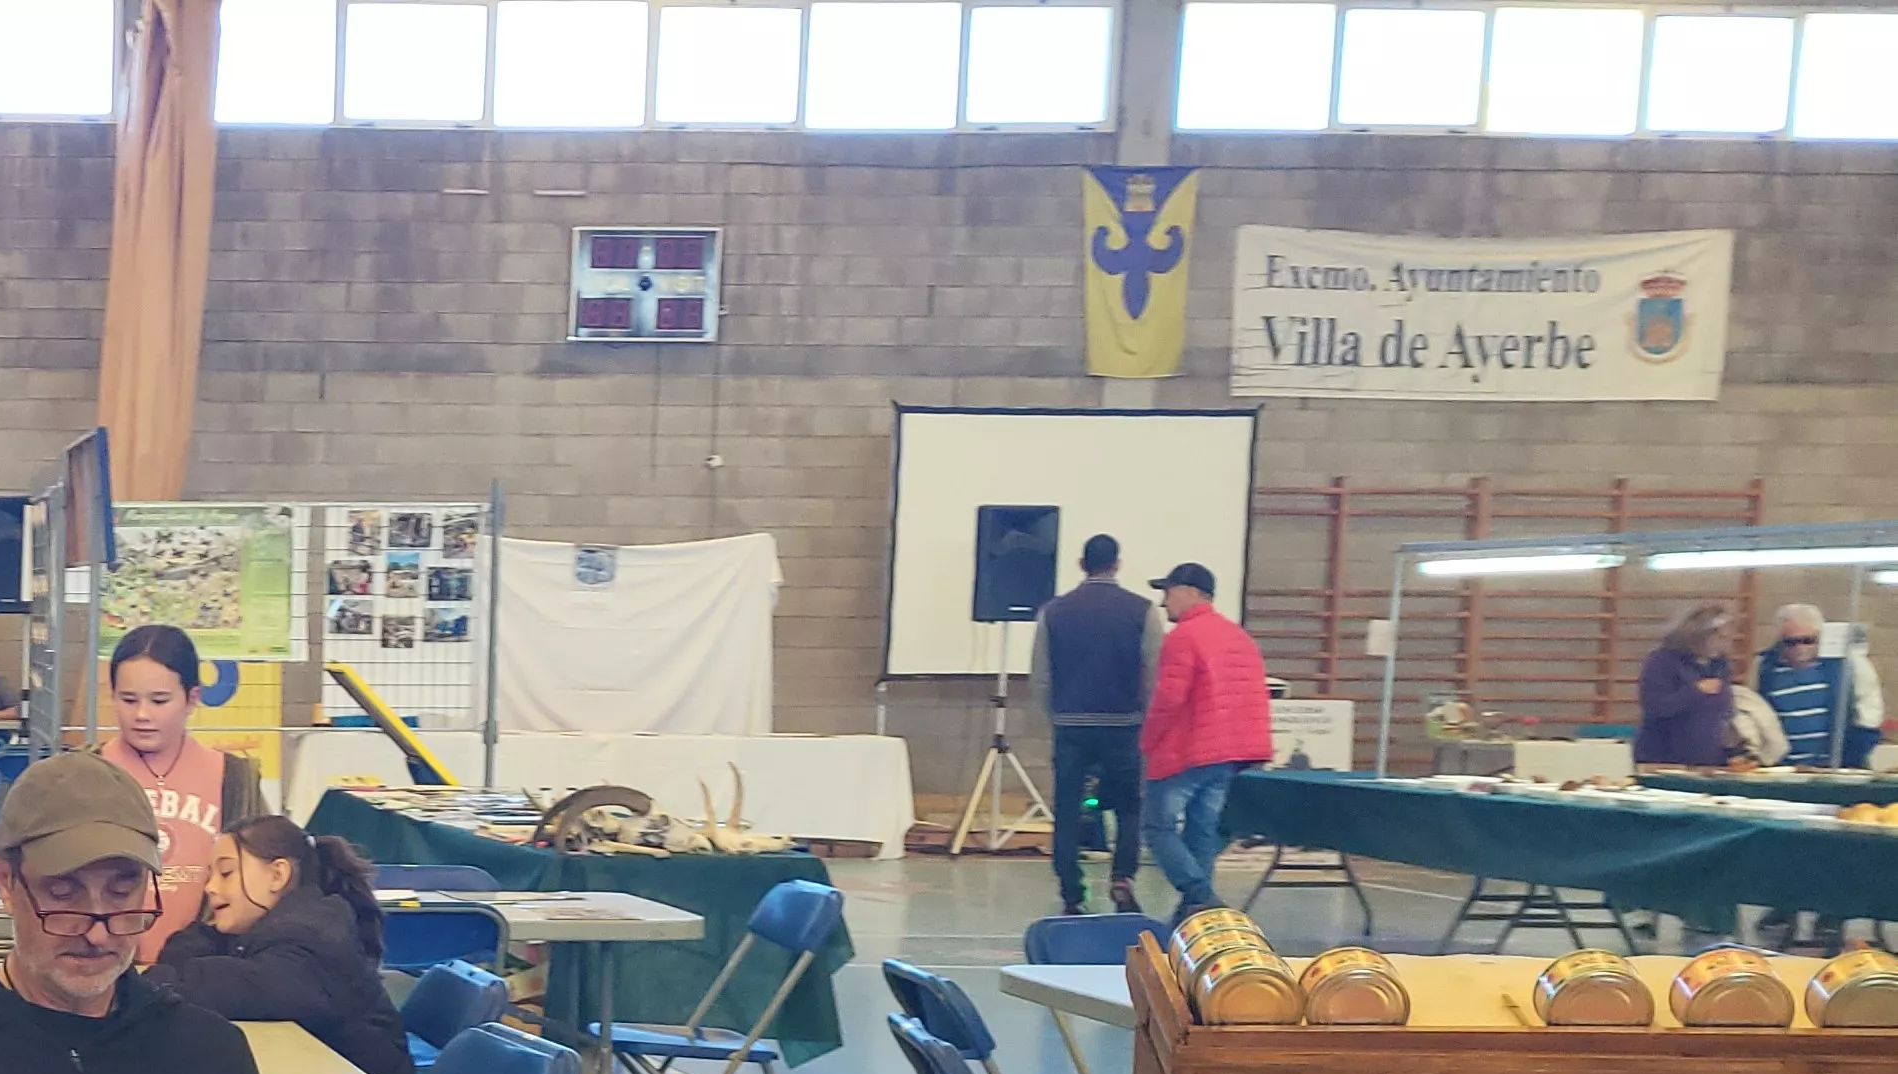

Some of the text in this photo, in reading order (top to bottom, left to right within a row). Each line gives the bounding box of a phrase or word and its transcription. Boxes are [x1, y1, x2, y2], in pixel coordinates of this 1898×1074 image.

[1265, 253, 1600, 302] Excmo. Ayuntamiento
[1261, 314, 1597, 384] Villa de Ayerbe
